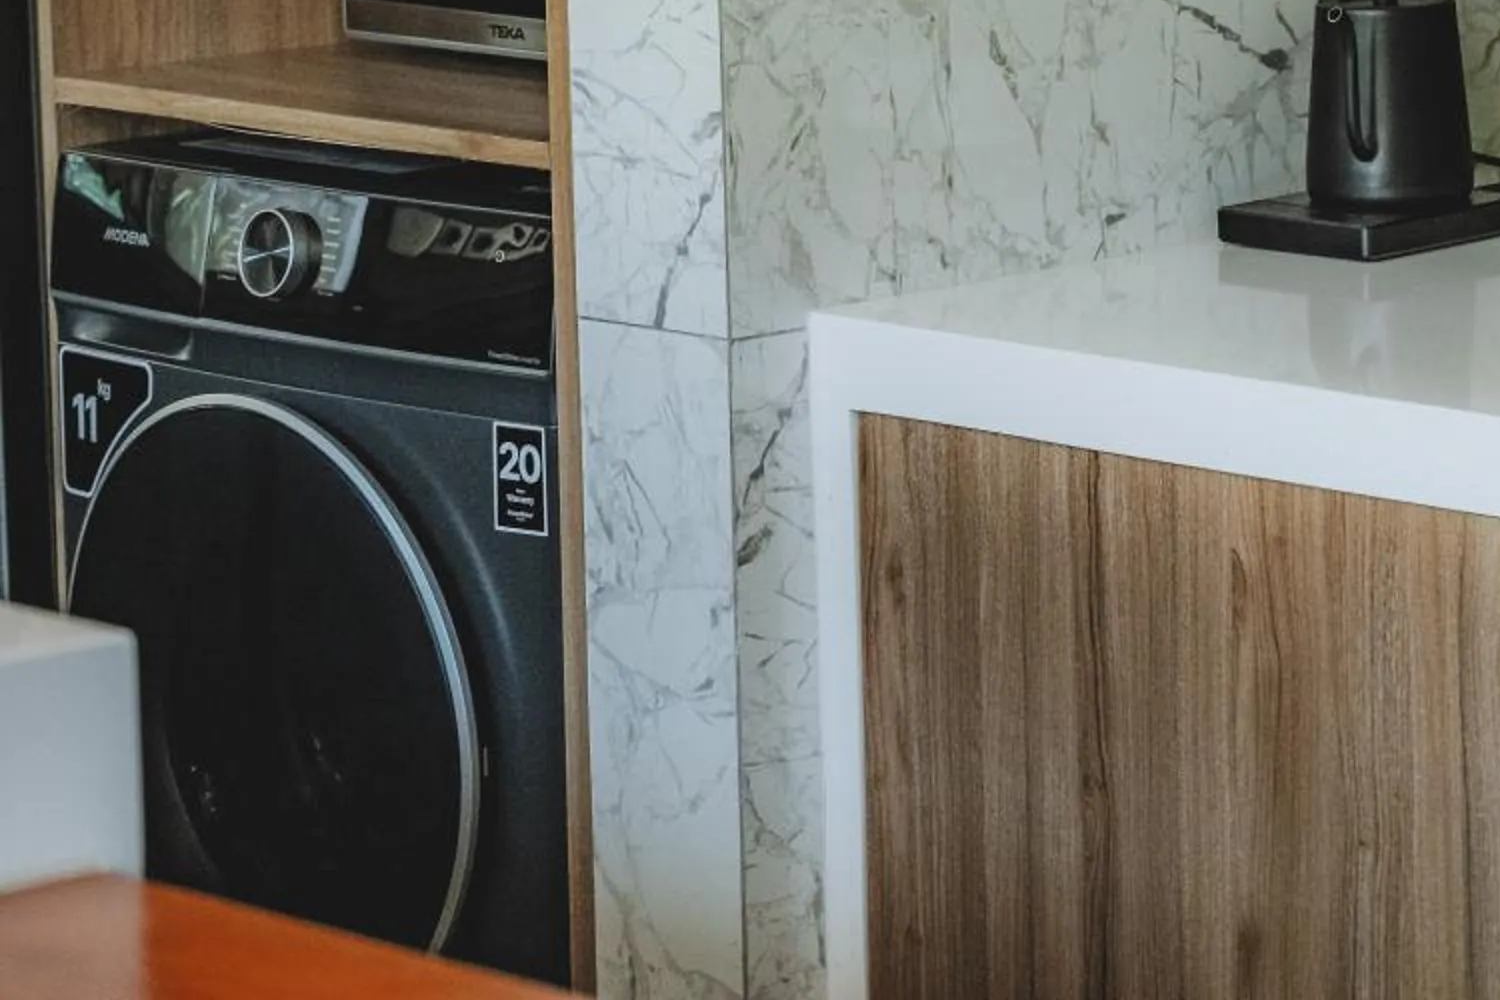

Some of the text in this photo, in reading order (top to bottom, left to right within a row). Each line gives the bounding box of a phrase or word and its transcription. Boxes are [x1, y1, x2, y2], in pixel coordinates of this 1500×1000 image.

[489, 23, 526, 41] TEKA
[72, 379, 111, 443] 11 kg
[500, 442, 541, 484] 20
